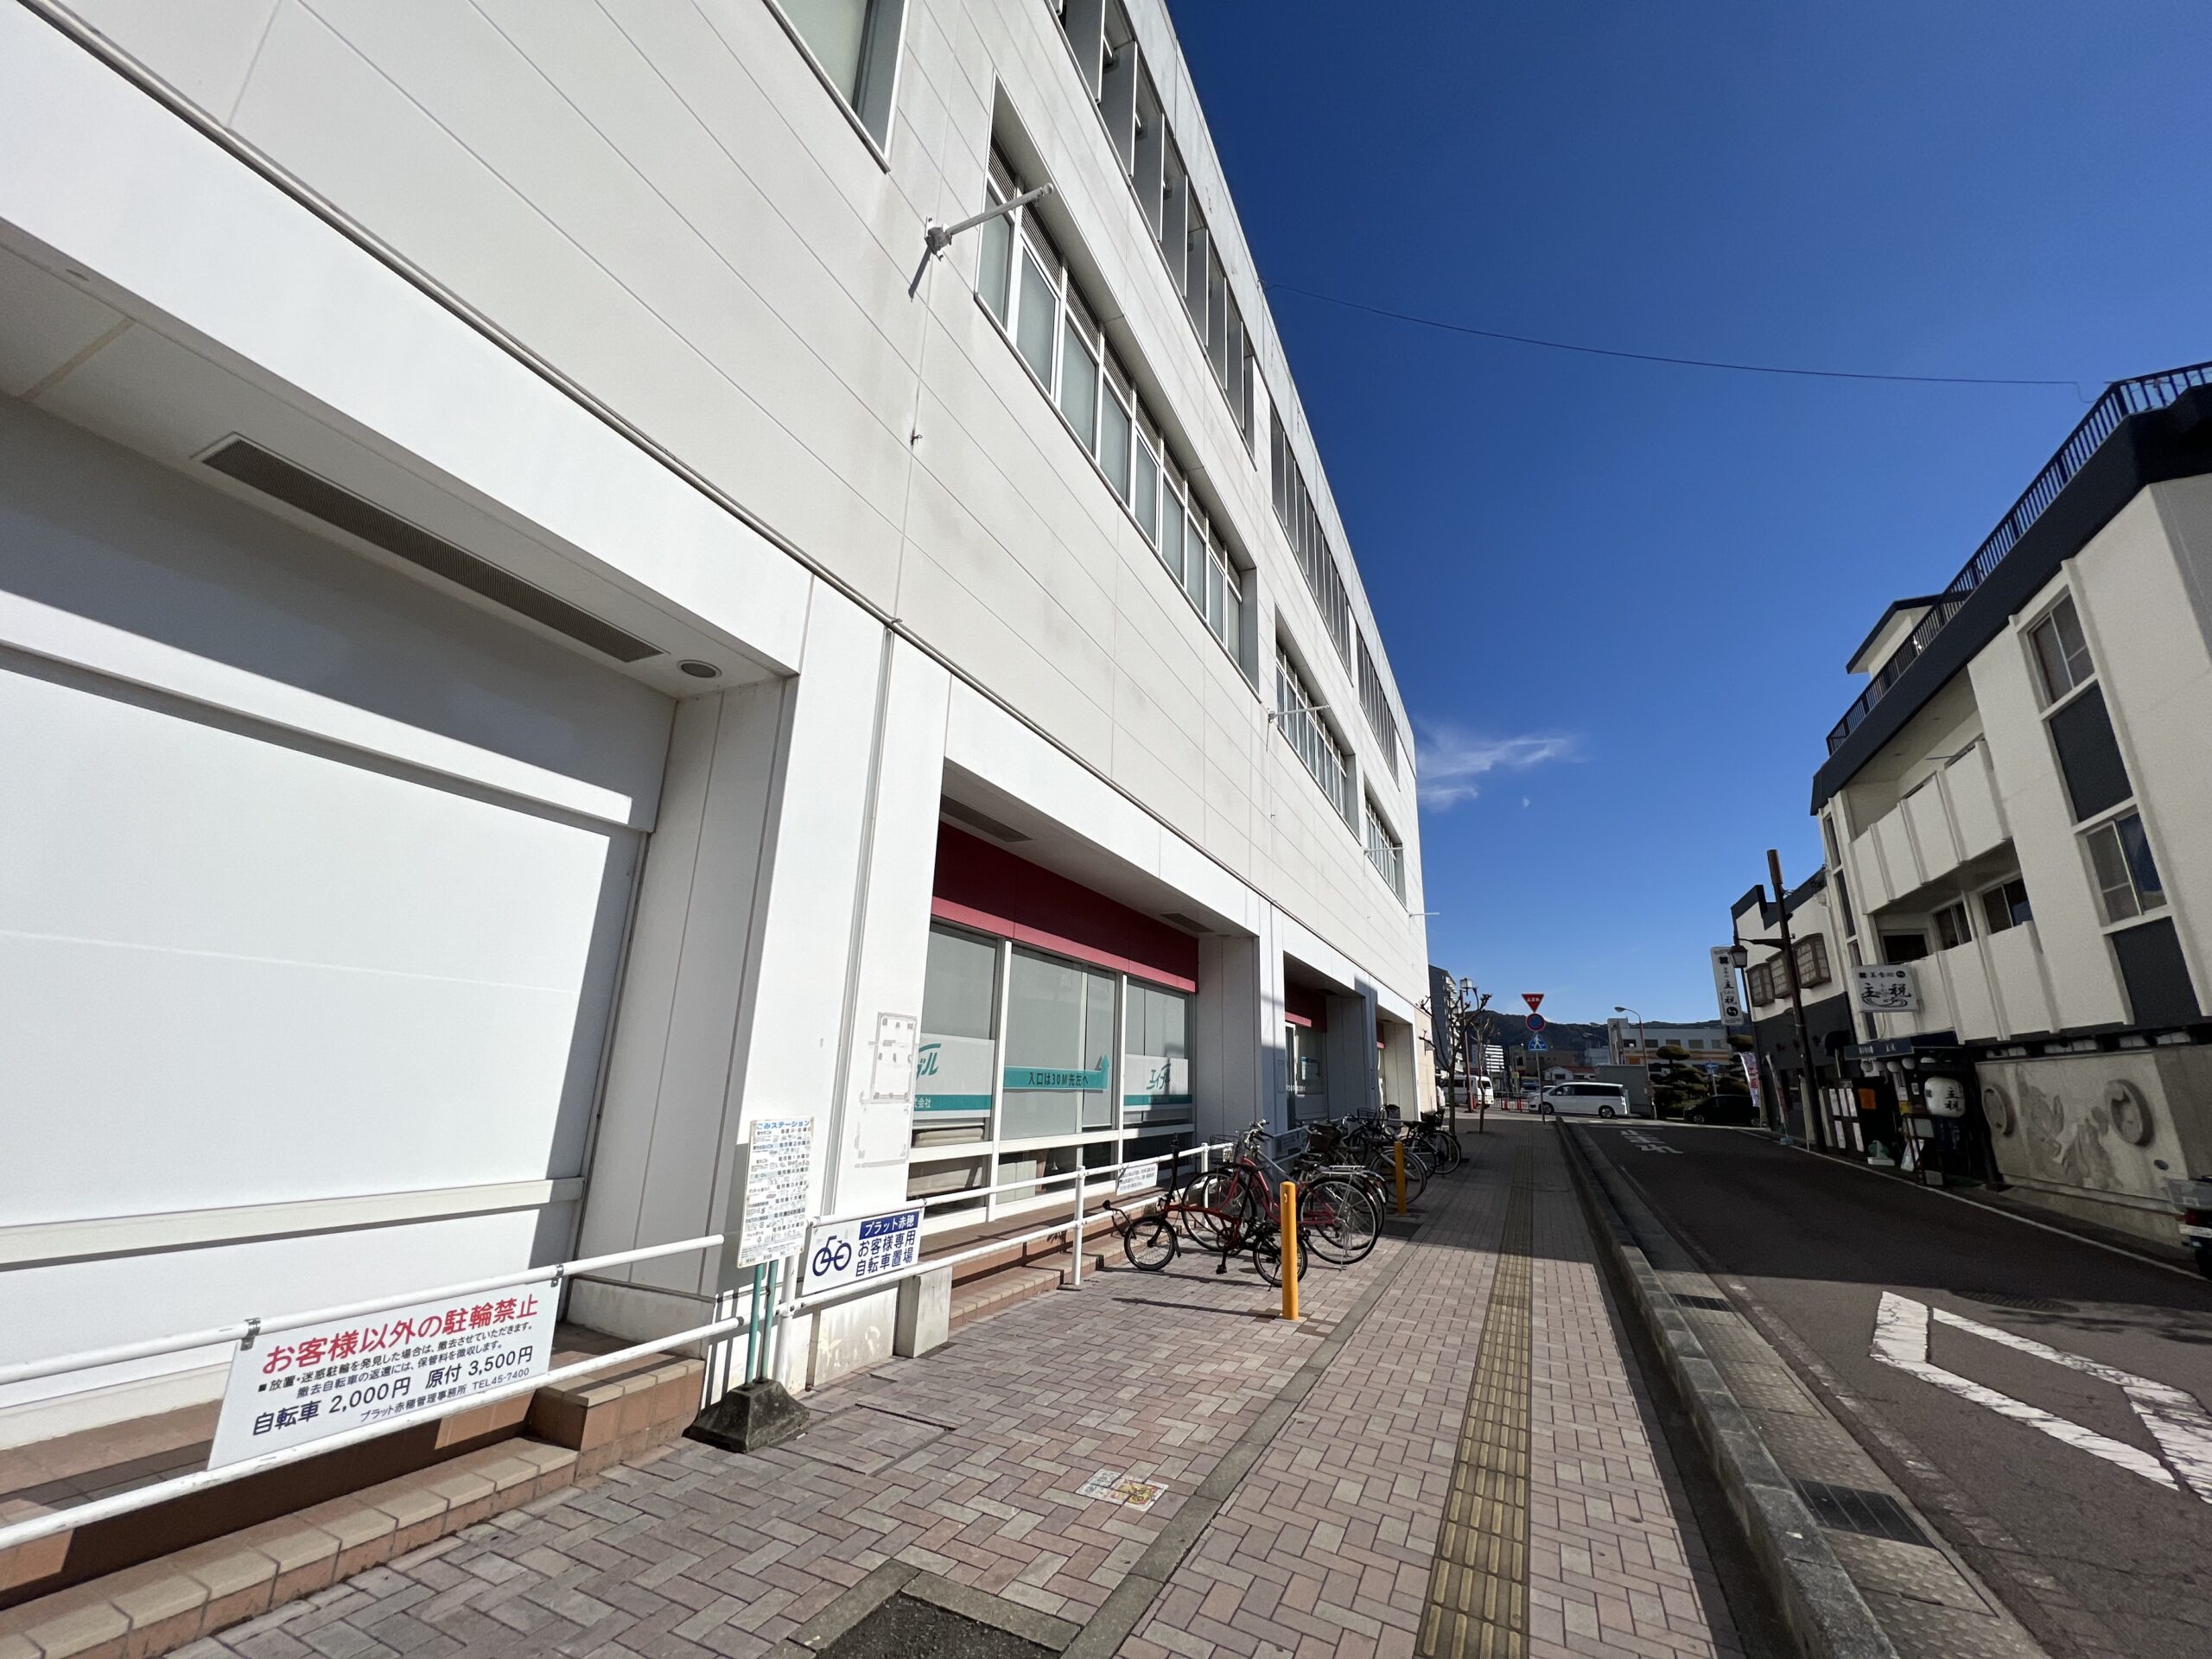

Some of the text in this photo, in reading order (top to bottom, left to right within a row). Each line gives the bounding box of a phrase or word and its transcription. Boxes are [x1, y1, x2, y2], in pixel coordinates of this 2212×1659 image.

[1028, 1072, 1090, 1086] 入口は30M先左へ
[857, 1230, 917, 1258] お客様専用
[855, 1247, 914, 1277] 自転車置場
[262, 1294, 539, 1375] お客様以外の駐輪禁止
[252, 1344, 533, 1436] 自転車 2,000円 原付 3,500円
[473, 1367, 530, 1391] TEL45-7400
